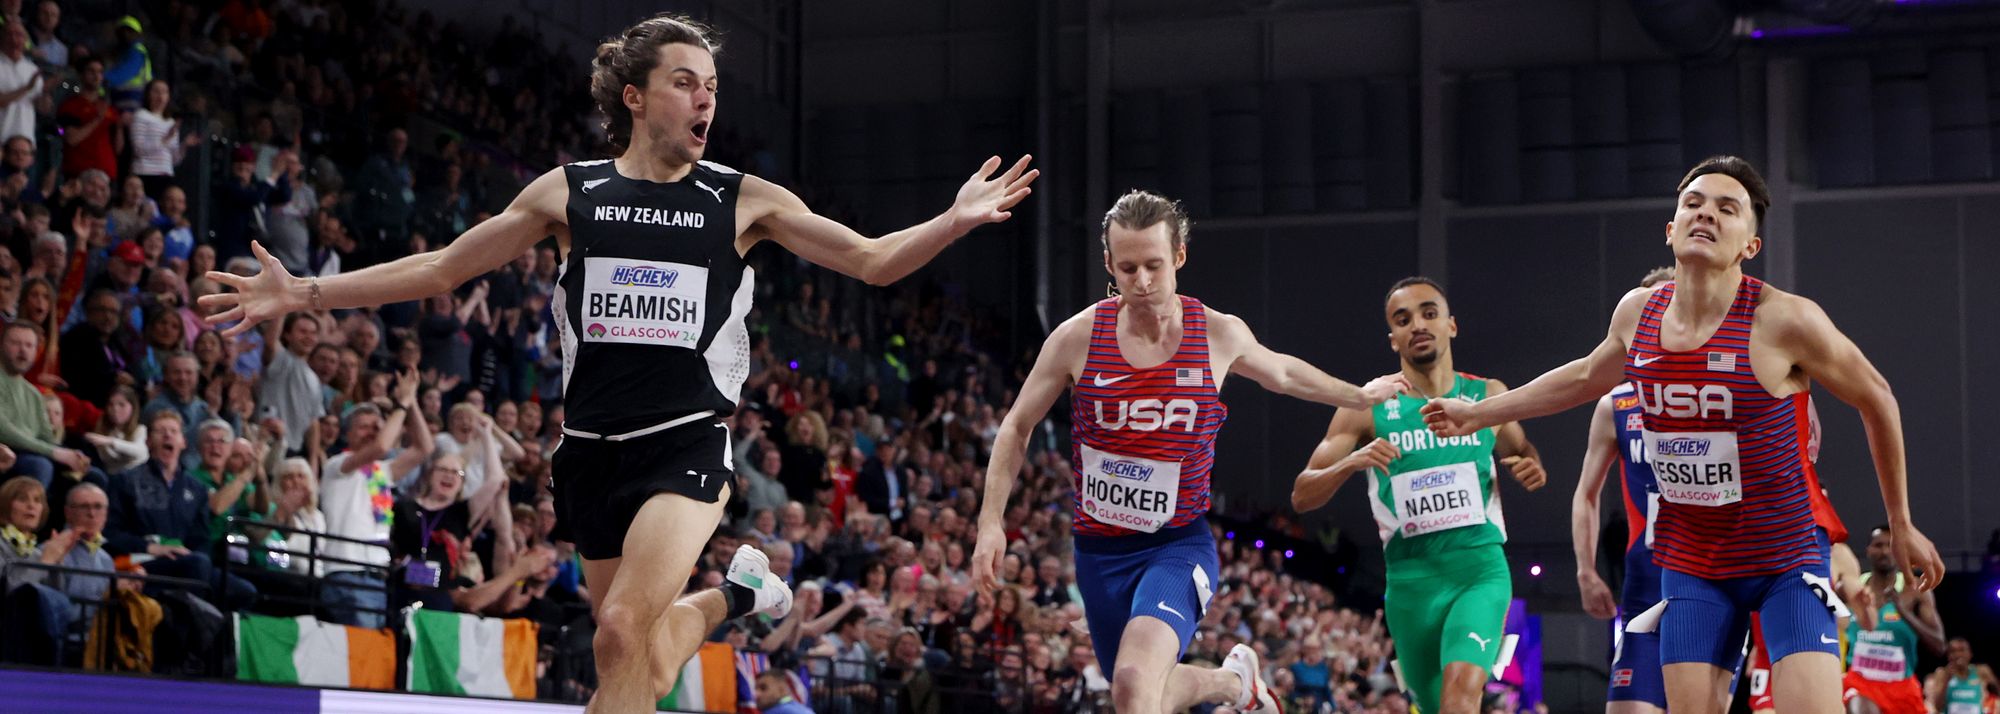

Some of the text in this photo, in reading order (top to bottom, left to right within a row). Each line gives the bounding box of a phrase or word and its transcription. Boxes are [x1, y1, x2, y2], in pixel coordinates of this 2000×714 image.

[594, 205, 705, 229] NEW ZEALAND
[611, 265, 679, 289] HI-CHEW
[589, 292, 697, 325] BEAMISH
[611, 326, 696, 342] GLASGOW 24
[1636, 381, 1733, 419] USA
[1094, 398, 1199, 432] USA
[1657, 438, 1711, 457] HI-CHEW
[1101, 458, 1154, 482] HI-CHEW
[1410, 471, 1457, 491] HI-CHEW
[1086, 474, 1169, 514] HOCKER
[1405, 490, 1472, 518] NADER
[1666, 488, 1739, 501] GLASGOW 24
[1098, 508, 1153, 527] GLASGOW
[1420, 513, 1470, 530] GLASGOW
